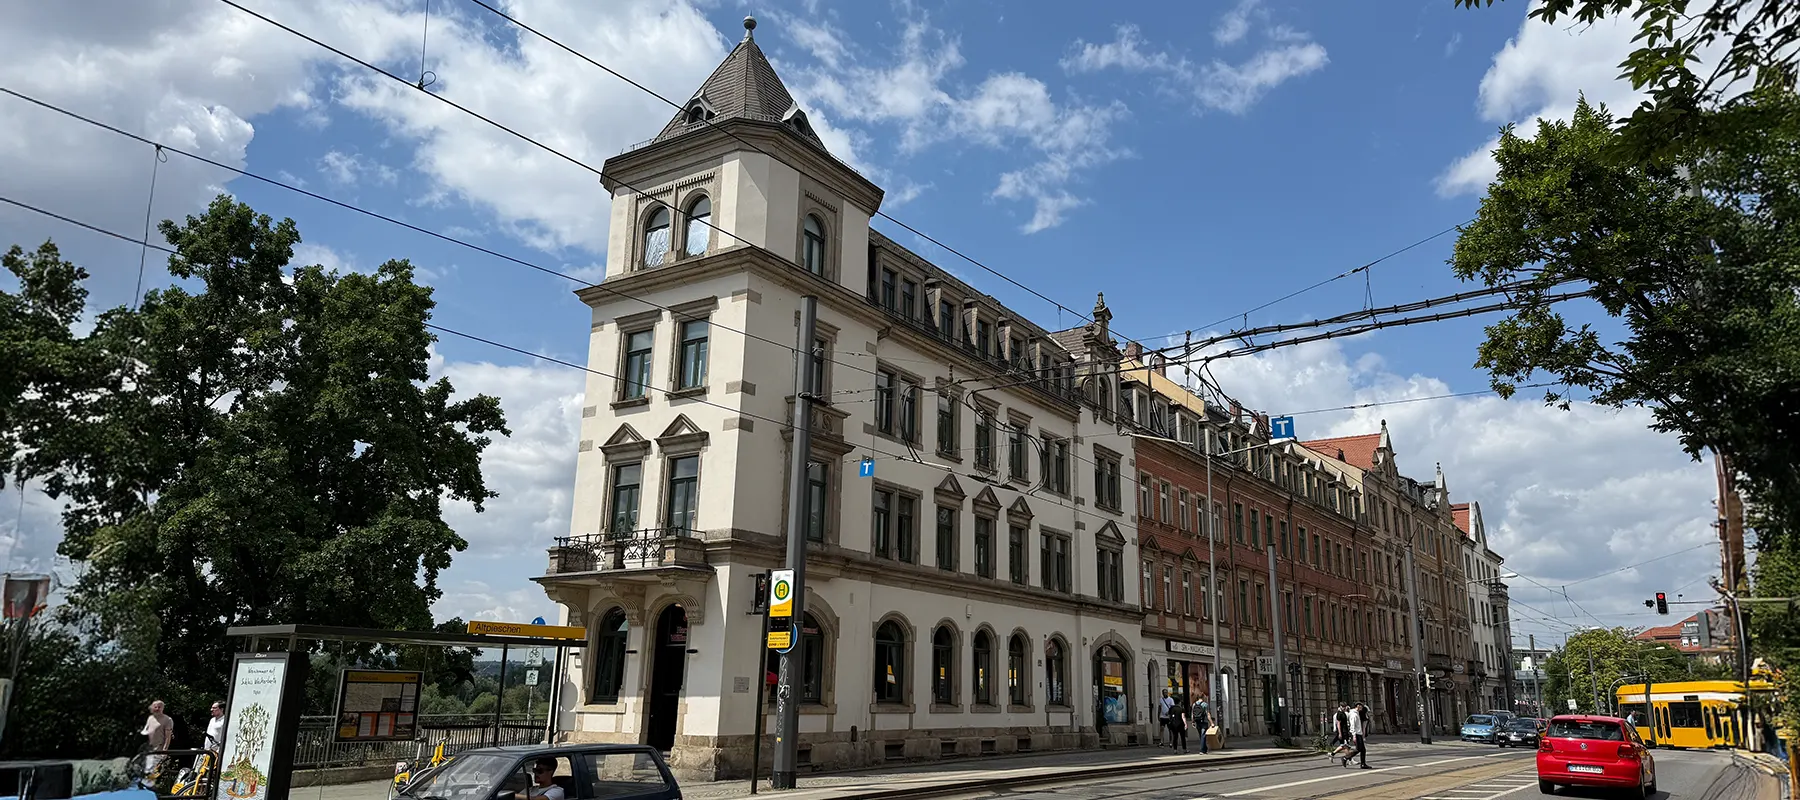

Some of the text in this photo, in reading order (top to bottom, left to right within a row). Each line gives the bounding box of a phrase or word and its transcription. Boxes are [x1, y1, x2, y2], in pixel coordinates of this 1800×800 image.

[1276, 420, 1289, 436] T
[863, 462, 872, 475] T
[778, 584, 786, 596] H
[474, 622, 521, 634] Altpieschen
